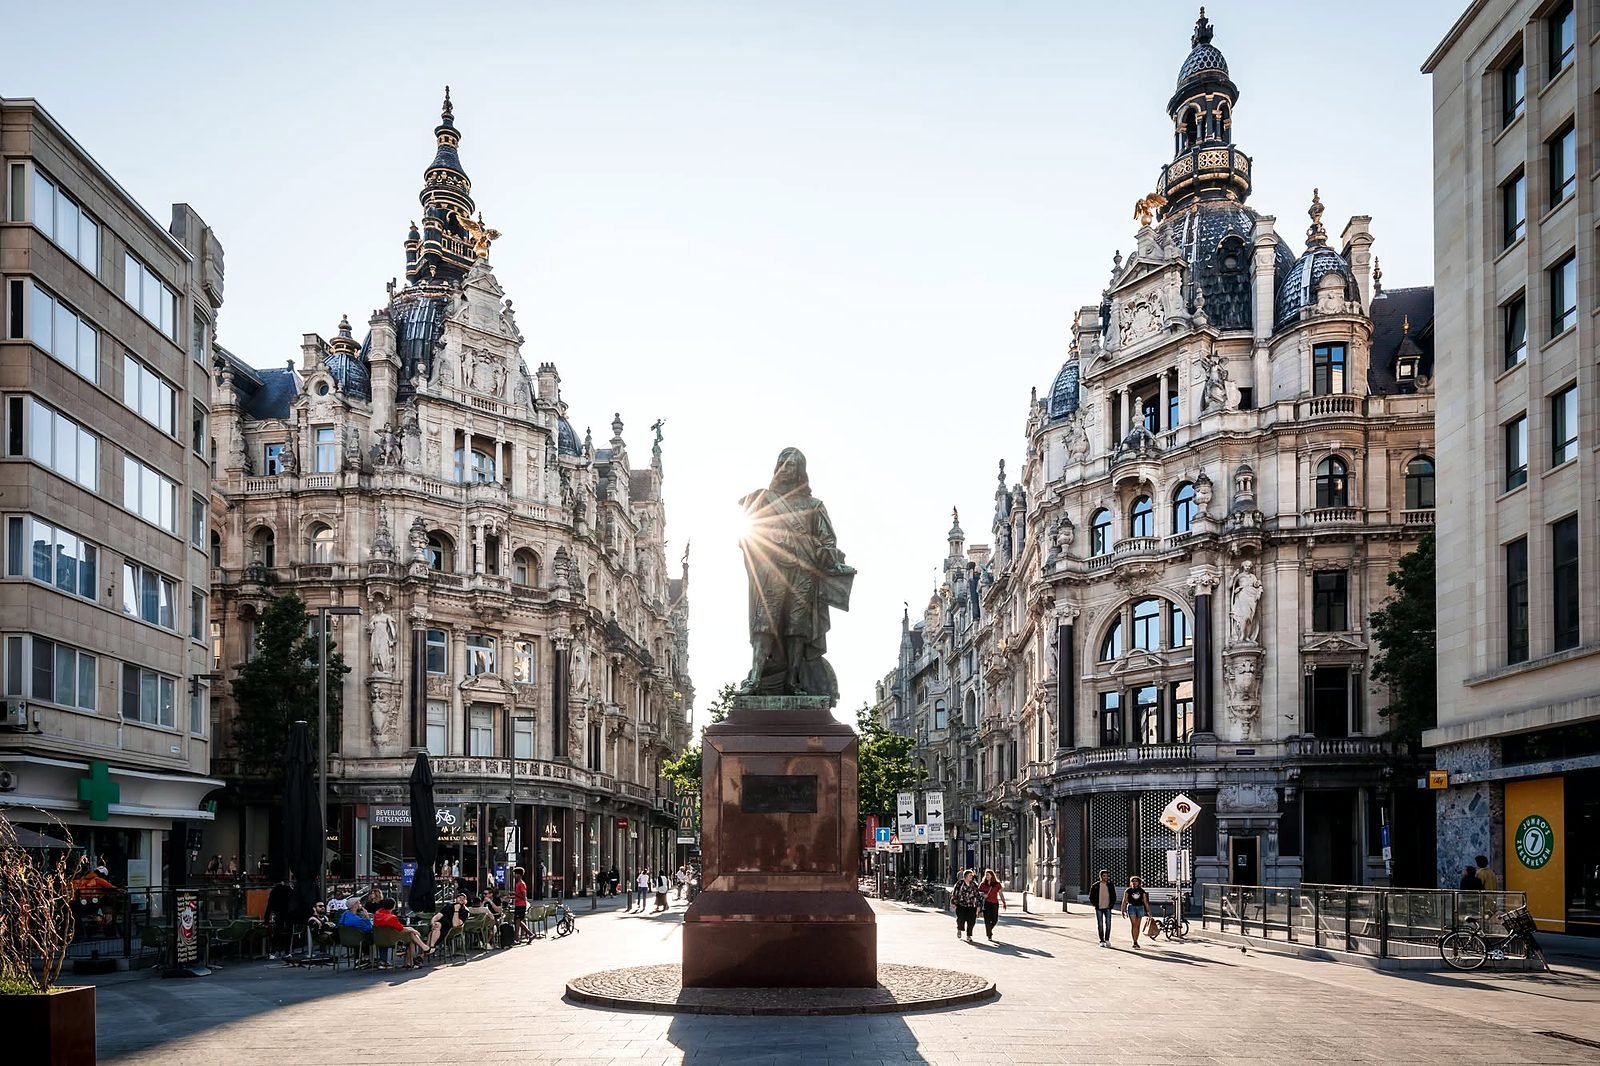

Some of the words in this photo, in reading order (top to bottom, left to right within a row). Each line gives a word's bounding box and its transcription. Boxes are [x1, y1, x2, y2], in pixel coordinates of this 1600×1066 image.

[1523, 818, 1550, 835] JUMBO'S
[1530, 832, 1539, 852] 7
[1516, 839, 1551, 867] ZEKERHEDEN
